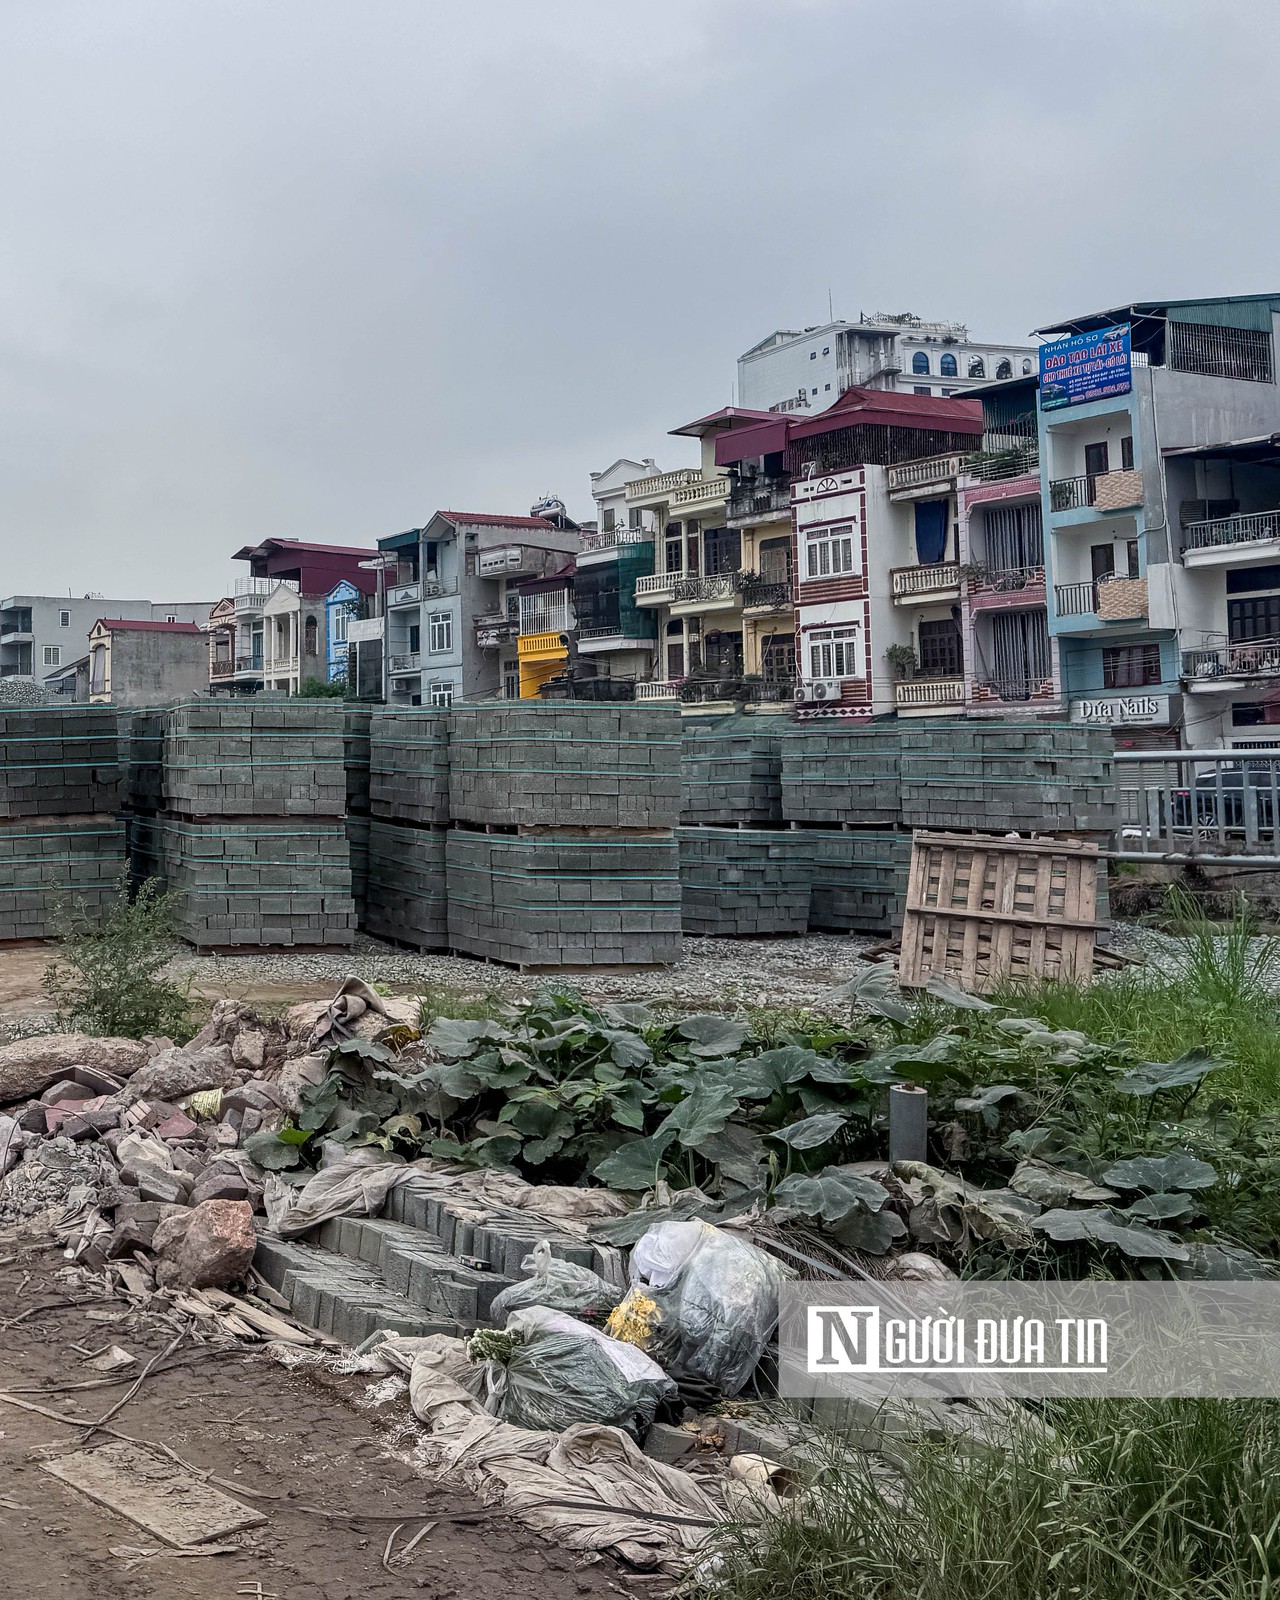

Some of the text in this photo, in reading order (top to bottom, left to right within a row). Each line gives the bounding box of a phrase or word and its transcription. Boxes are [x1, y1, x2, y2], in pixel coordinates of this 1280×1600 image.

[1045, 340, 1123, 370] ĐÀO TẠO LÁI XE
[1081, 697, 1158, 718] Dứa Nails
